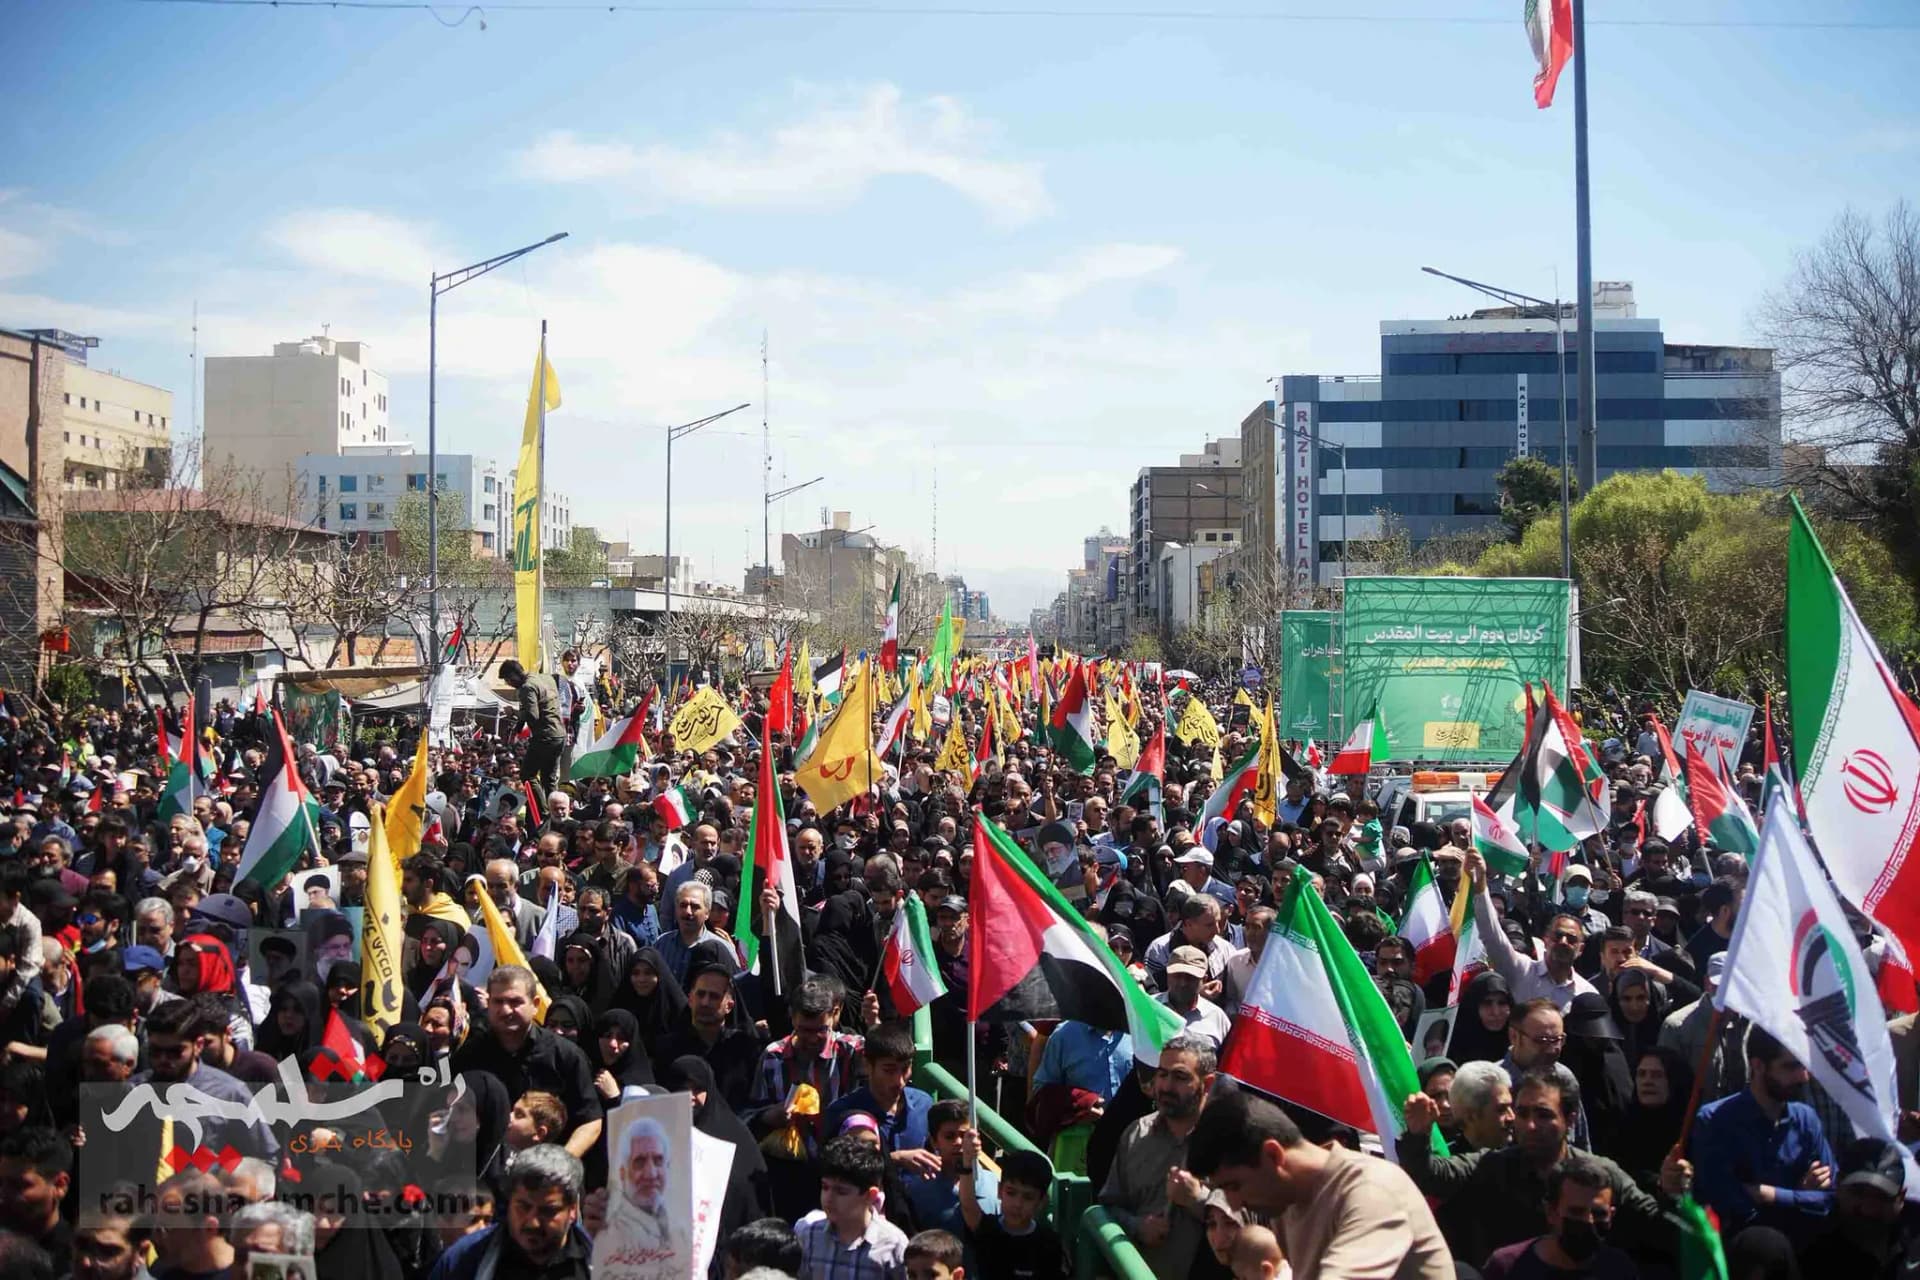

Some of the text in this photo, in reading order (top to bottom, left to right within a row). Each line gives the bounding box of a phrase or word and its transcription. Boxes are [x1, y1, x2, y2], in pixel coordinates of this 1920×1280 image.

[1296, 410, 1308, 468] RAZI
[1296, 476, 1309, 550] HOTEL
[1365, 624, 1422, 644] المقدس
